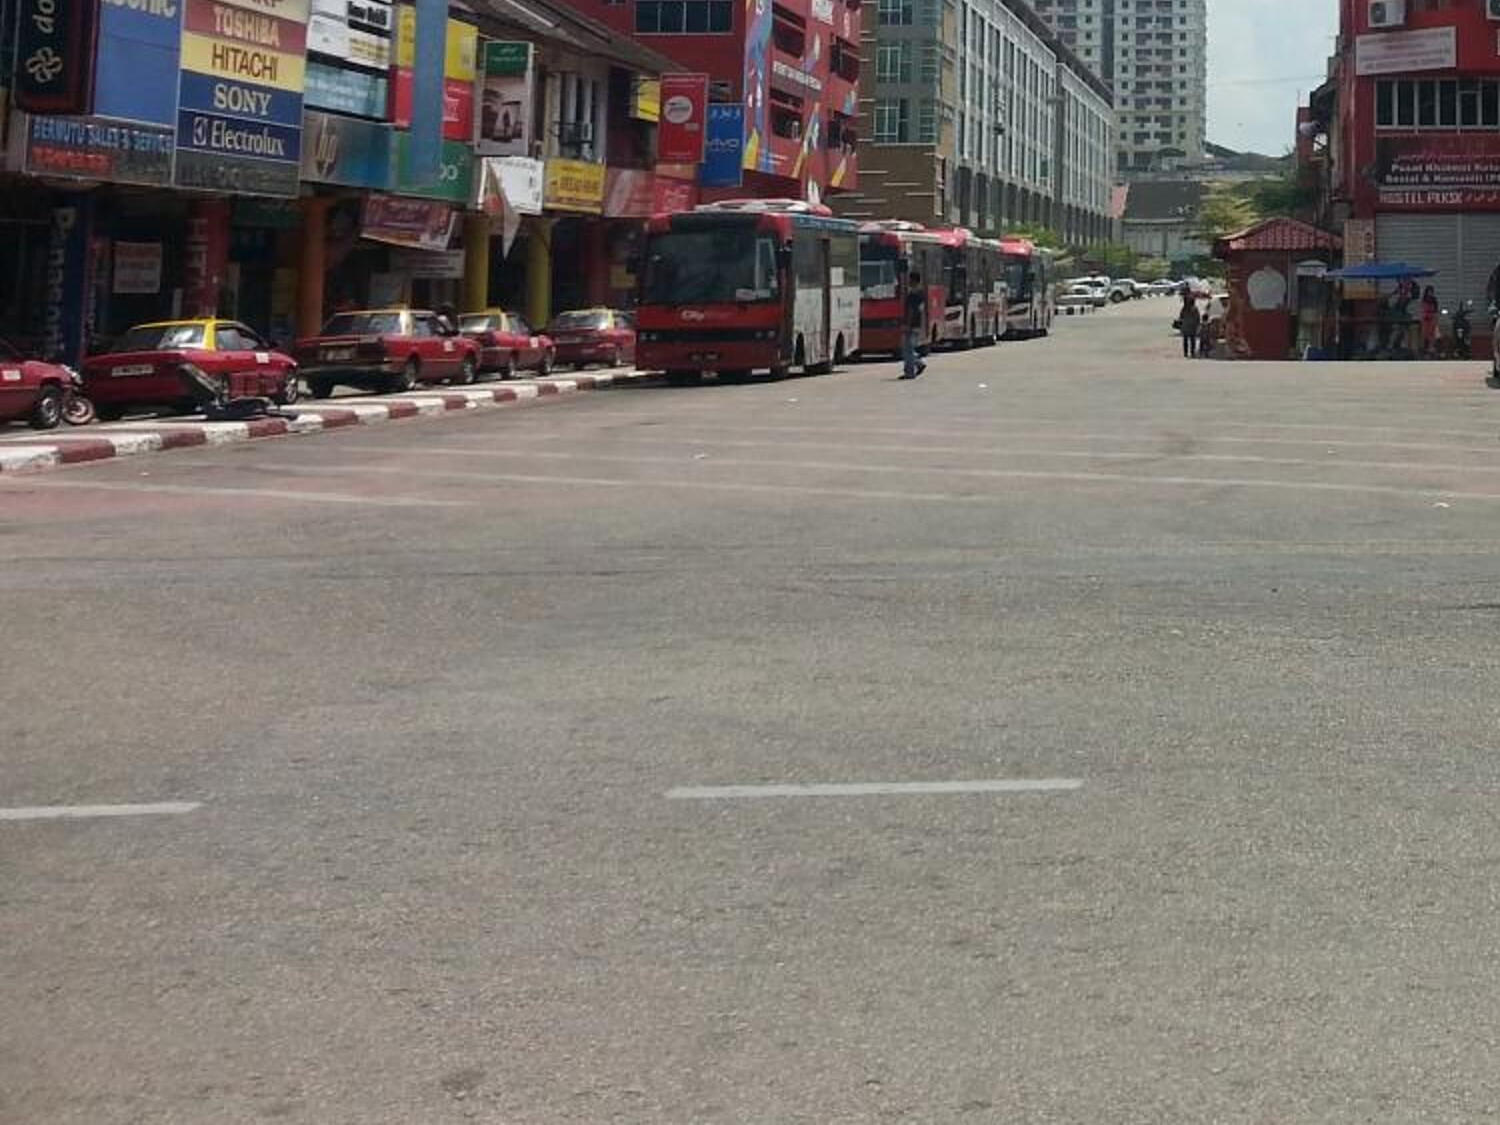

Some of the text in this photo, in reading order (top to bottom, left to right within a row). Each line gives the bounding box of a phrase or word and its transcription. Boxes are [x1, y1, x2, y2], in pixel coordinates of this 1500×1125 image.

[213, 5, 281, 47] TOSHIBA
[211, 42, 279, 82] HITACHI
[213, 82, 272, 116] SONY
[211, 119, 285, 157] Electrolux
